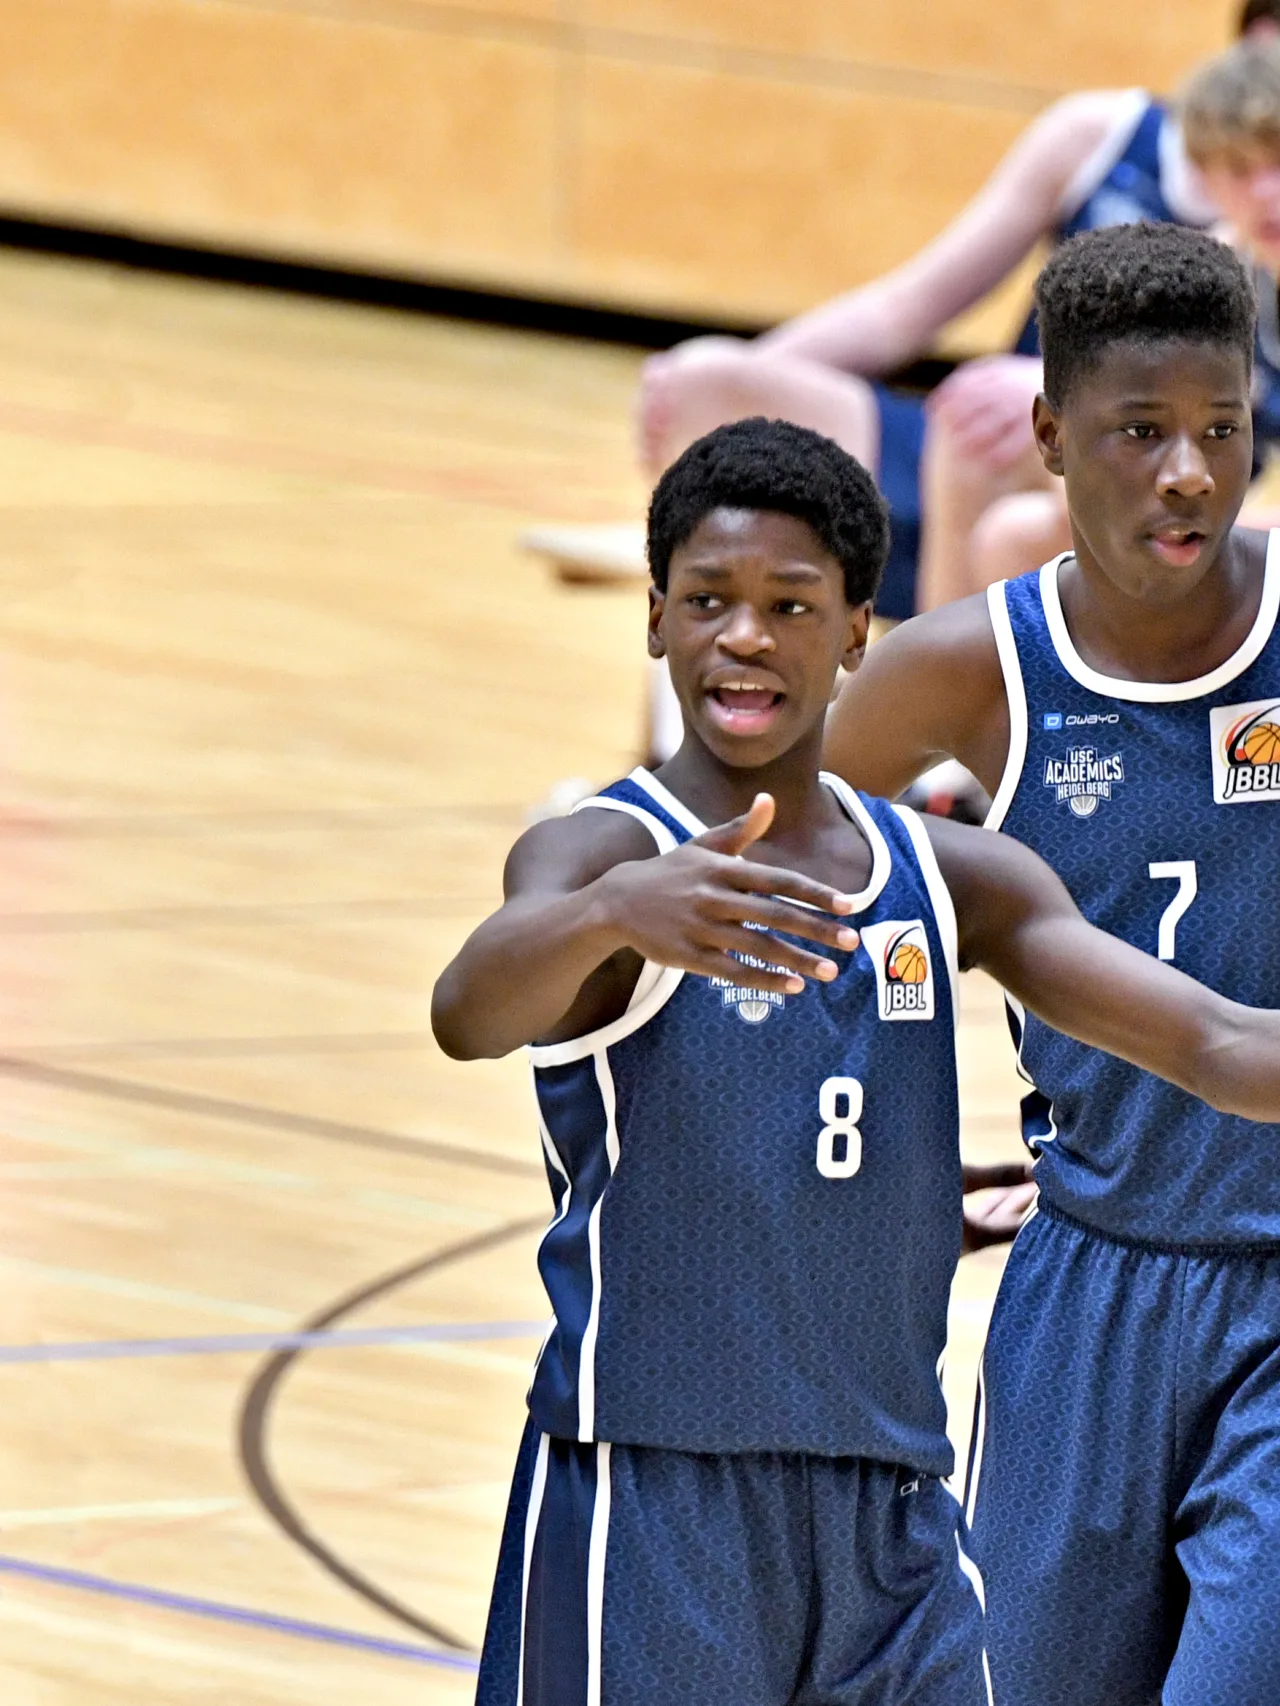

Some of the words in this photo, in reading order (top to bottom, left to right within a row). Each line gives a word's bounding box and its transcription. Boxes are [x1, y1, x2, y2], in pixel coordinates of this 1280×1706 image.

[1045, 755, 1122, 785] ACADEMICS
[1070, 749, 1094, 764] USC
[1057, 781, 1110, 801] HEIDELBERG
[1148, 860, 1198, 960] 7
[723, 986, 783, 1004] HEIDELBERG
[884, 983, 926, 1016] JBBL
[816, 1076, 864, 1179] 8
